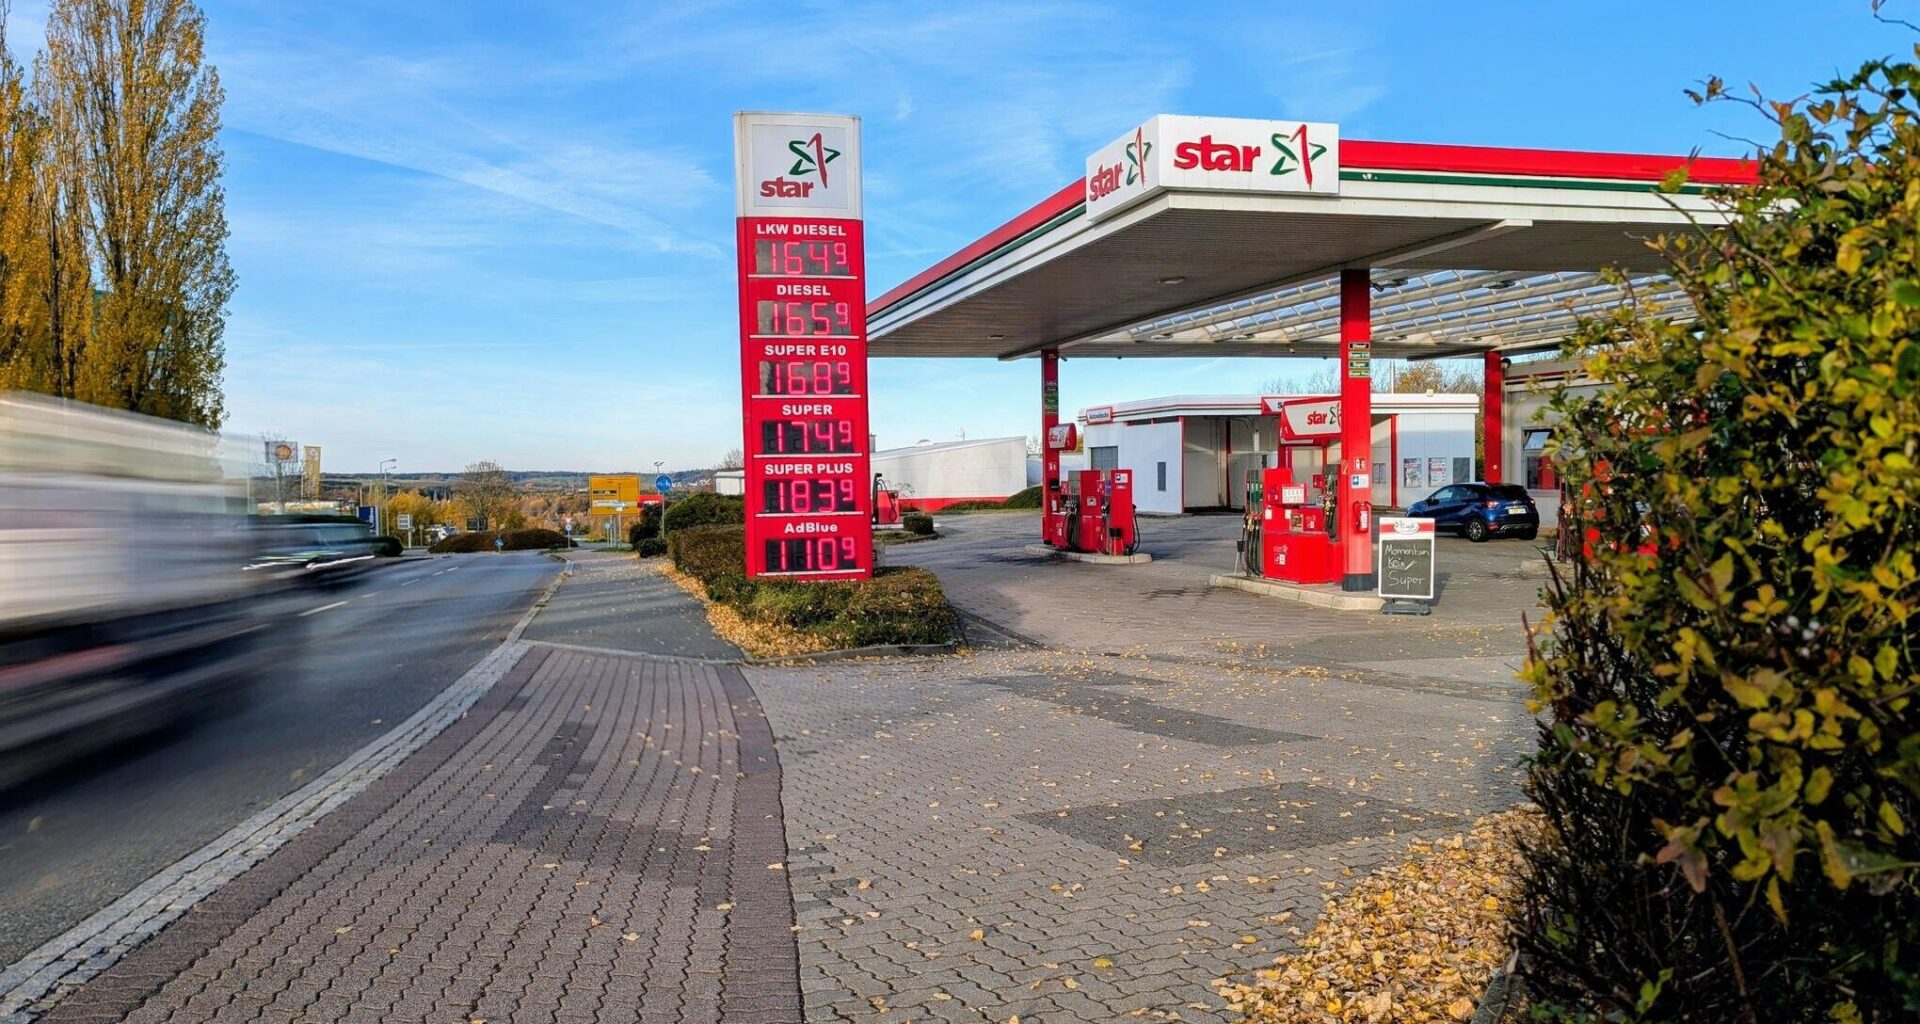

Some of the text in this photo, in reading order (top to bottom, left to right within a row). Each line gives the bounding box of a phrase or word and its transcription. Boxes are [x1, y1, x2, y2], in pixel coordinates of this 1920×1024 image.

[1173, 135, 1261, 172] star
[760, 176, 814, 198] star
[1089, 162, 1123, 201] star
[757, 223, 847, 236] LKW DIESEL
[776, 284, 831, 296] DIESEL
[764, 344, 847, 356] SUPER E10
[782, 404, 833, 415] SUPER
[1306, 411, 1328, 425] star
[764, 463, 854, 475] SUPER PLUS
[784, 522, 838, 534] AdBlue
[1384, 543, 1430, 556] Momentan
[1388, 570, 1425, 591] Super
